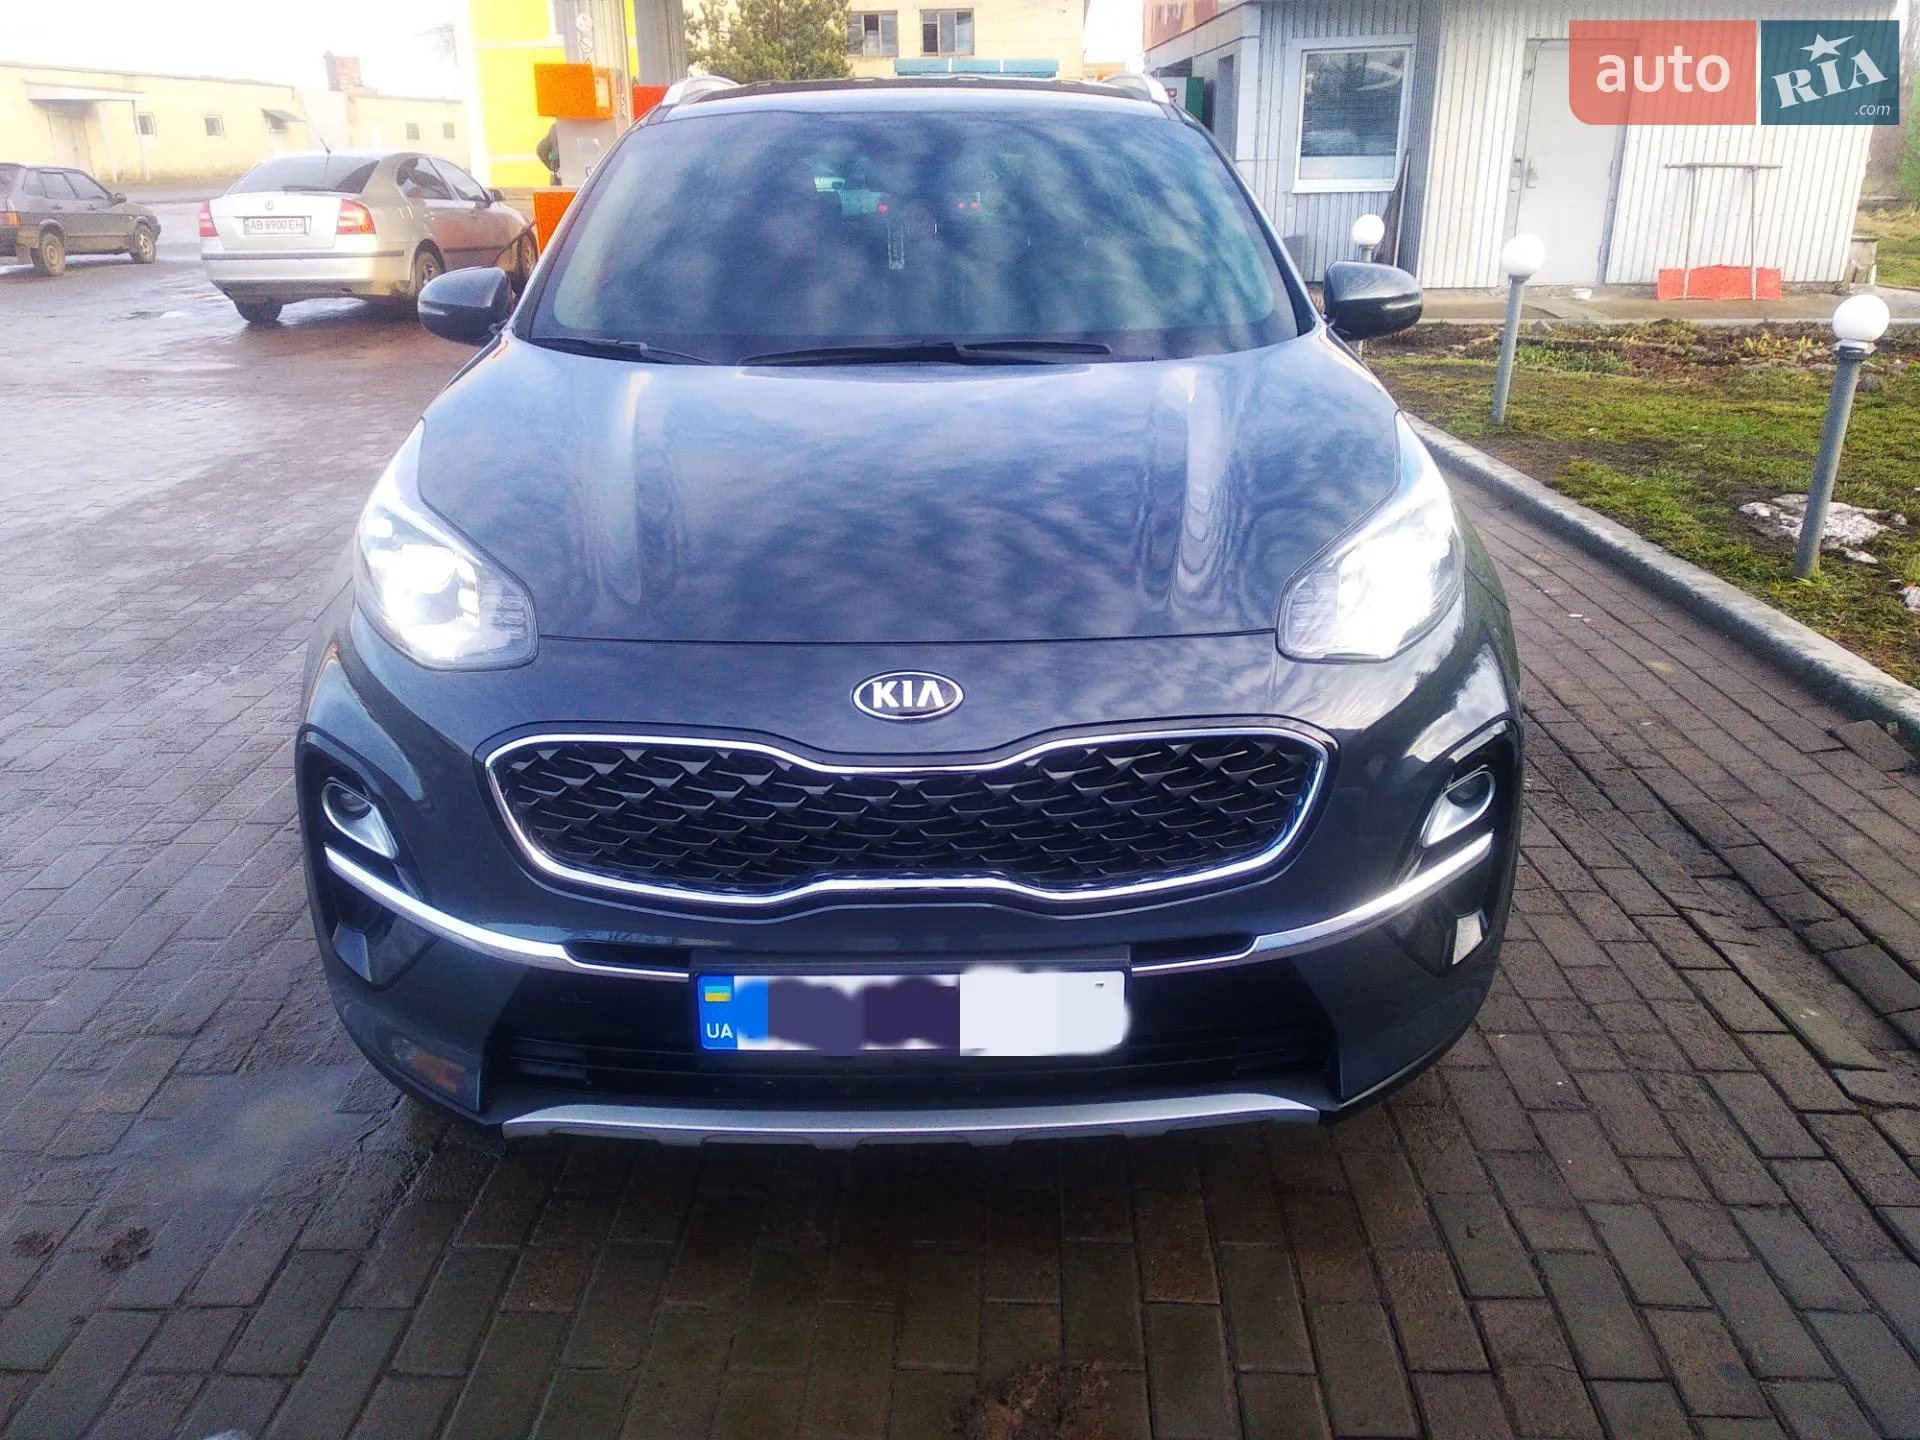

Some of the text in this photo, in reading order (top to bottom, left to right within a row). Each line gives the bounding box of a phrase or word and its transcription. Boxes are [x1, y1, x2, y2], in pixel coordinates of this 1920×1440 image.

[264, 219, 288, 230] 8900
[872, 680, 946, 709] KIA
[706, 1022, 734, 1039] UA
